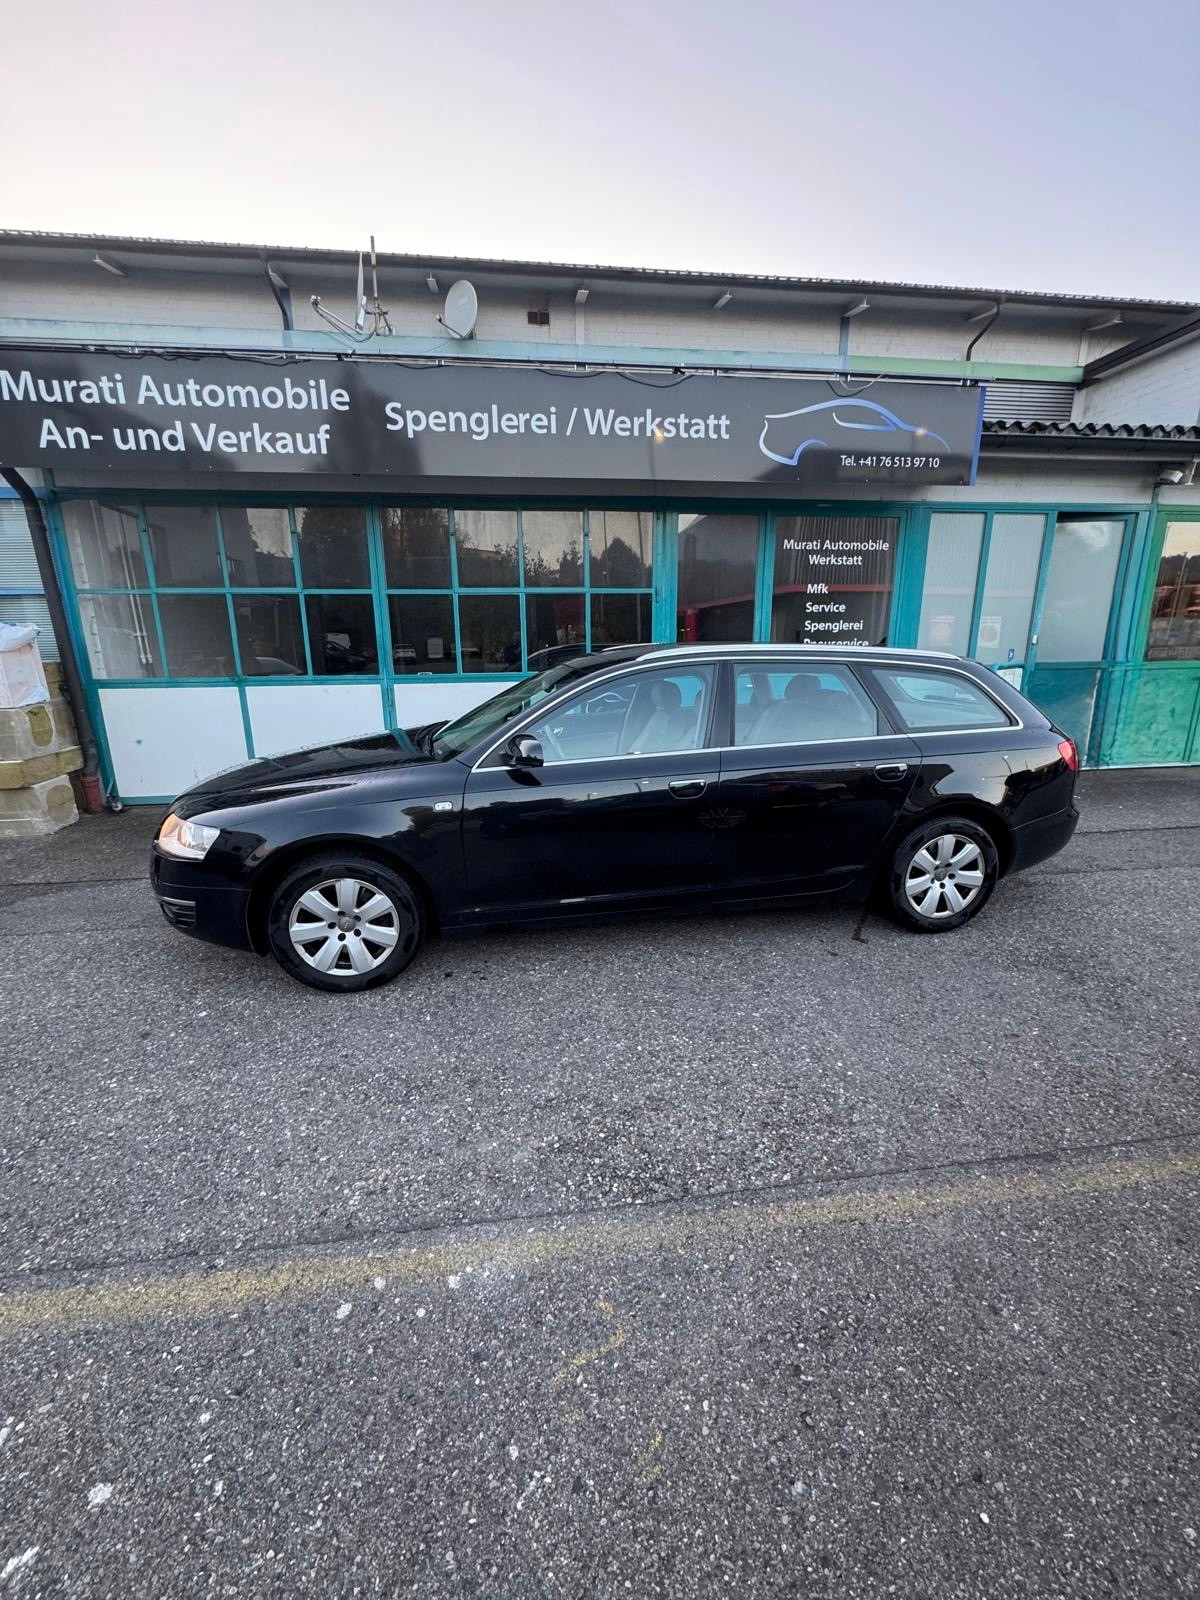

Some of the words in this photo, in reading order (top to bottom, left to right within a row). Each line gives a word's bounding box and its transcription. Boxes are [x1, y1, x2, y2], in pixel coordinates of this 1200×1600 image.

[0, 370, 126, 404] Murati
[138, 374, 350, 411] Automobile
[385, 402, 557, 440] Spenglerei
[584, 408, 731, 440] Werkstatt
[40, 419, 104, 449] An-
[113, 421, 186, 452] und
[191, 423, 331, 455] Verkauf
[840, 455, 857, 467] Tel.
[858, 456, 877, 467] +41
[879, 457, 892, 468] 76
[893, 457, 912, 468] 513
[913, 457, 926, 468] 97
[928, 458, 940, 468] 10
[783, 539, 821, 550] Murati
[822, 540, 890, 551] Automobile
[808, 554, 863, 566] Werkstatt
[806, 583, 829, 594] Mfk
[805, 602, 846, 613] Service
[804, 619, 864, 633] Spenglerei
